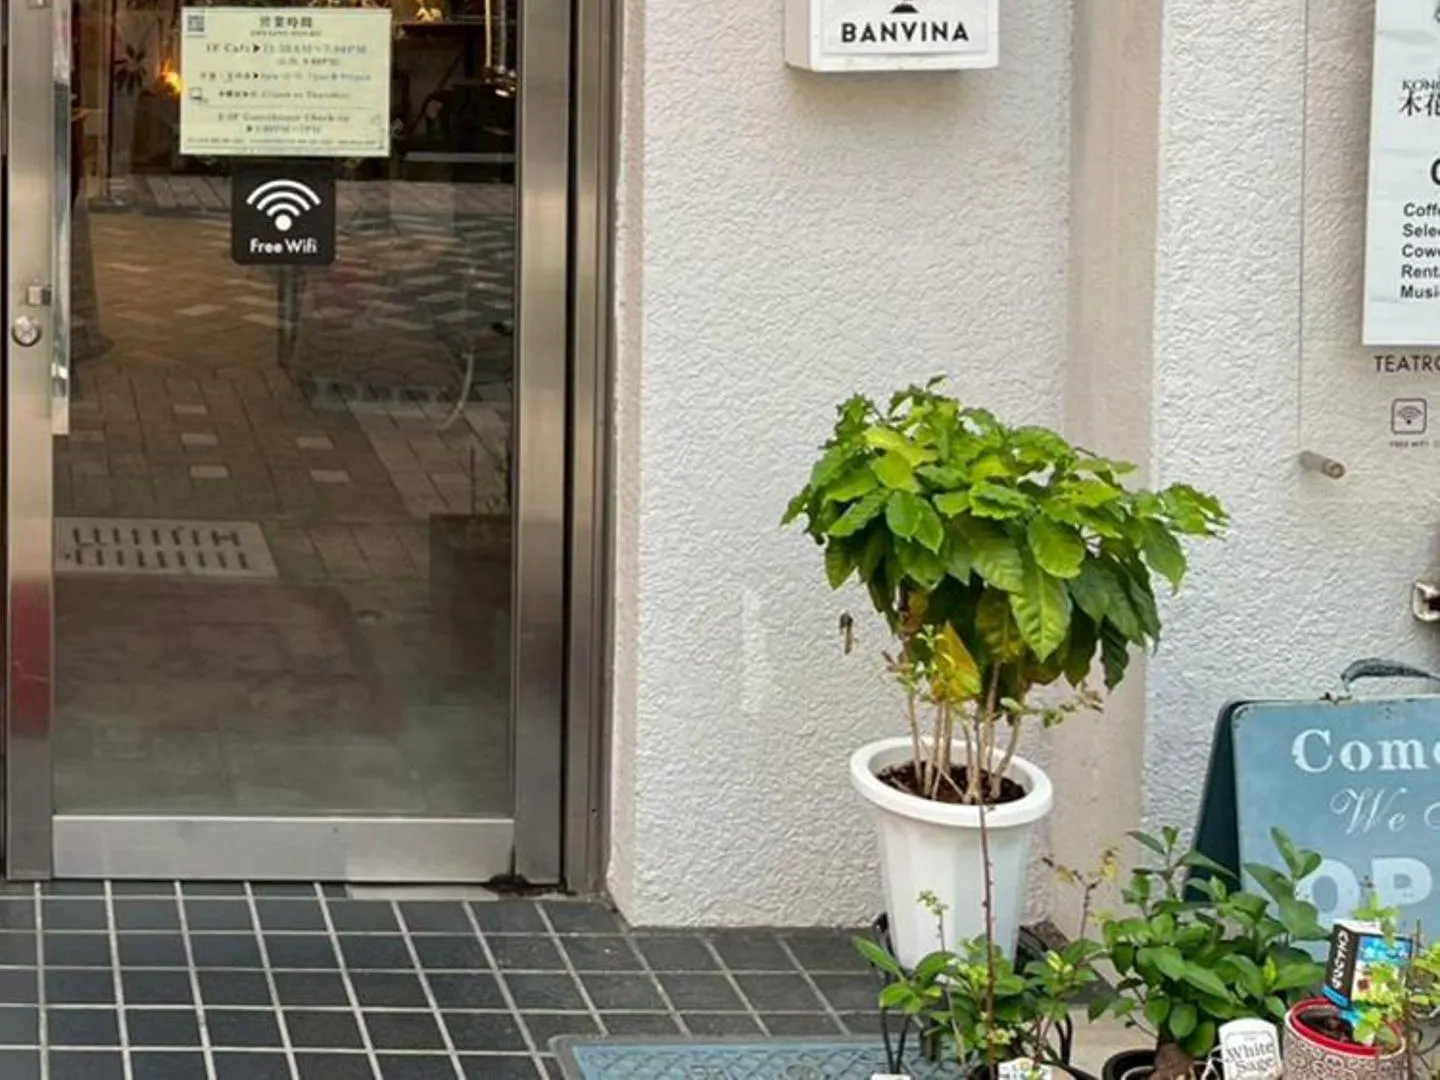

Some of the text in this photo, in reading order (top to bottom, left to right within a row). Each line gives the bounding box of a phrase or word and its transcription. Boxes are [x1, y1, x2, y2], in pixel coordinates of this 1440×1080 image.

[841, 21, 969, 43] BANVINA
[1403, 202, 1440, 217] Coff
[1402, 223, 1440, 238] Sele
[250, 237, 283, 254] Free
[1402, 244, 1440, 258] Cow
[1401, 264, 1440, 279] Rent
[1329, 787, 1408, 834] We
[1225, 1041, 1274, 1062] White
